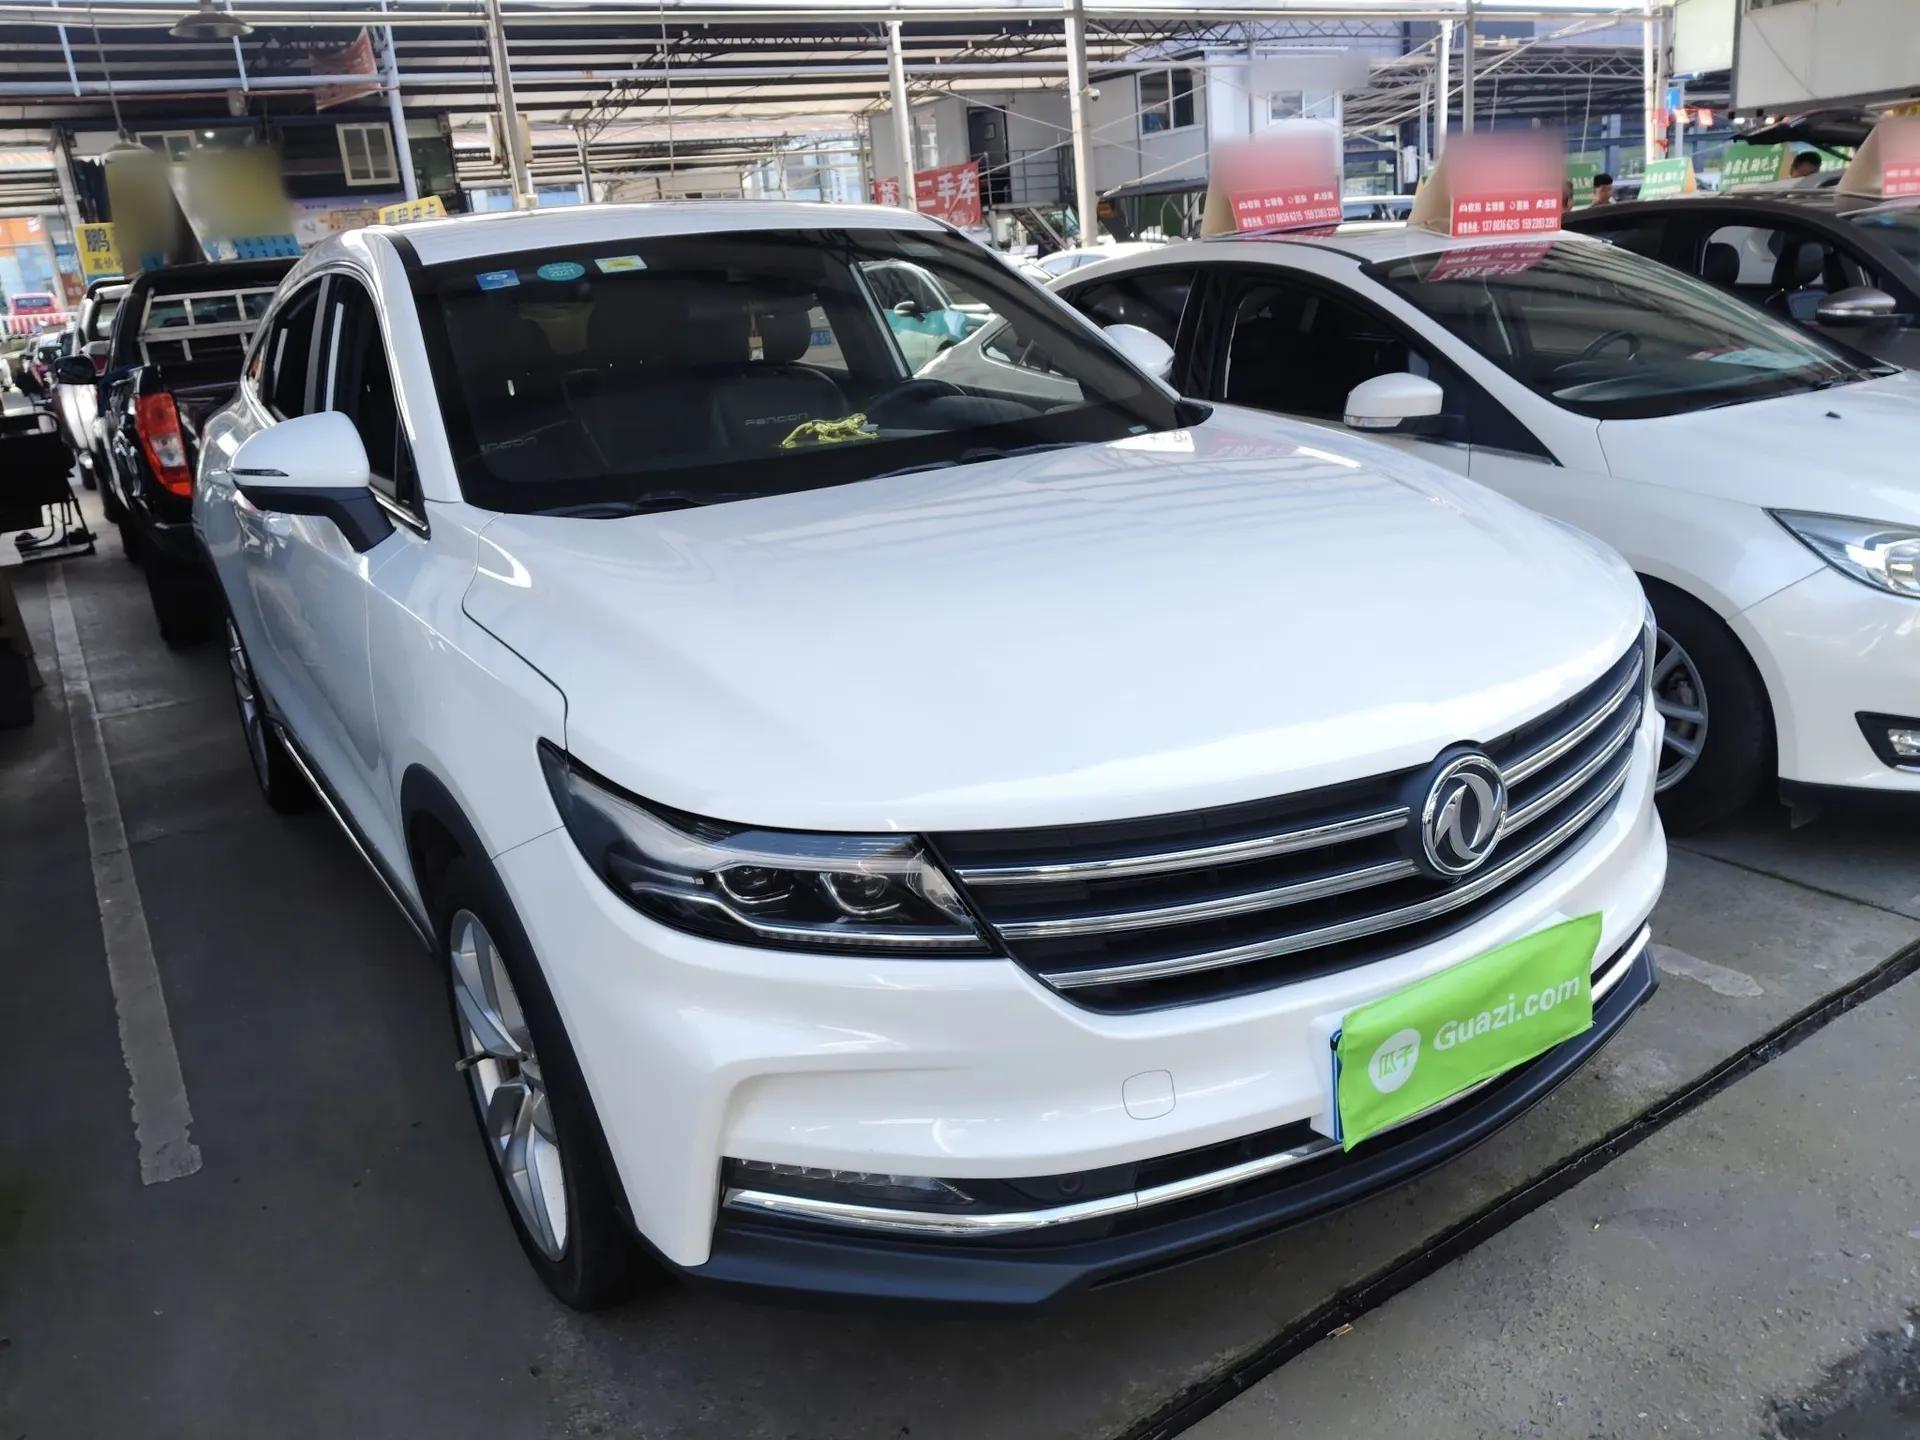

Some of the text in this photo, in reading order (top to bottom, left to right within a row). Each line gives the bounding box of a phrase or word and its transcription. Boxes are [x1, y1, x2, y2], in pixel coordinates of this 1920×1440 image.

[918, 169, 977, 209] 二手车
[550, 268, 575, 277] 2021
[1433, 975, 1581, 1052] Guazi.com
[1376, 1039, 1415, 1079] 瓜子
